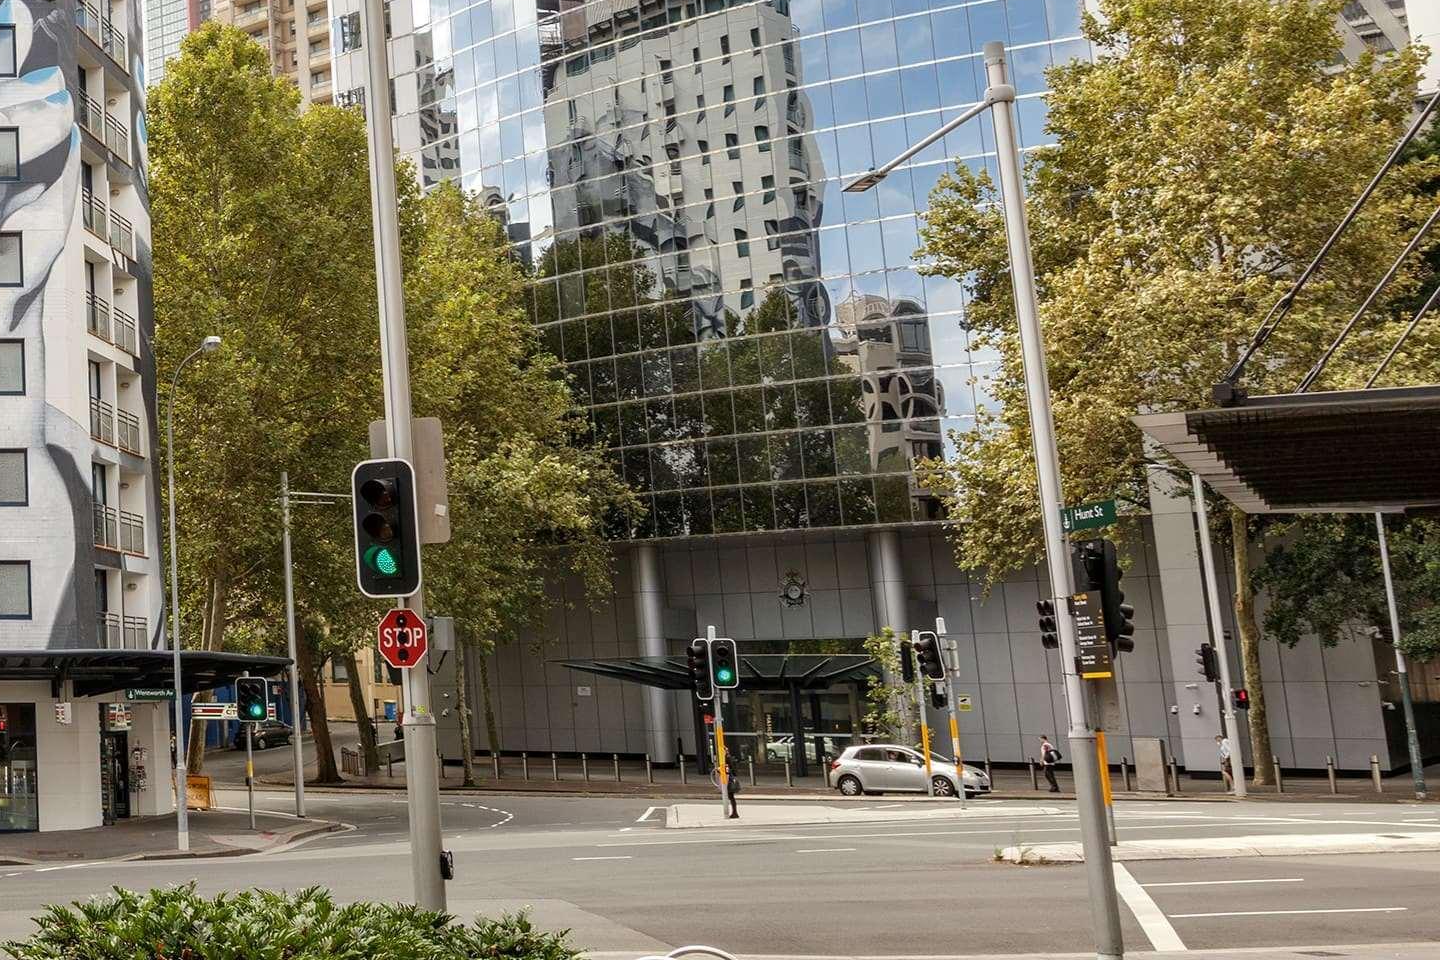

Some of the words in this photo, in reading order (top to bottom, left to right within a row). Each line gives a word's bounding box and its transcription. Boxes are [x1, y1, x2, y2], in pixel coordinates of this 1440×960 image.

[1074, 509, 1094, 520] Hunt
[1094, 505, 1104, 517] St
[383, 627, 423, 648] STOP
